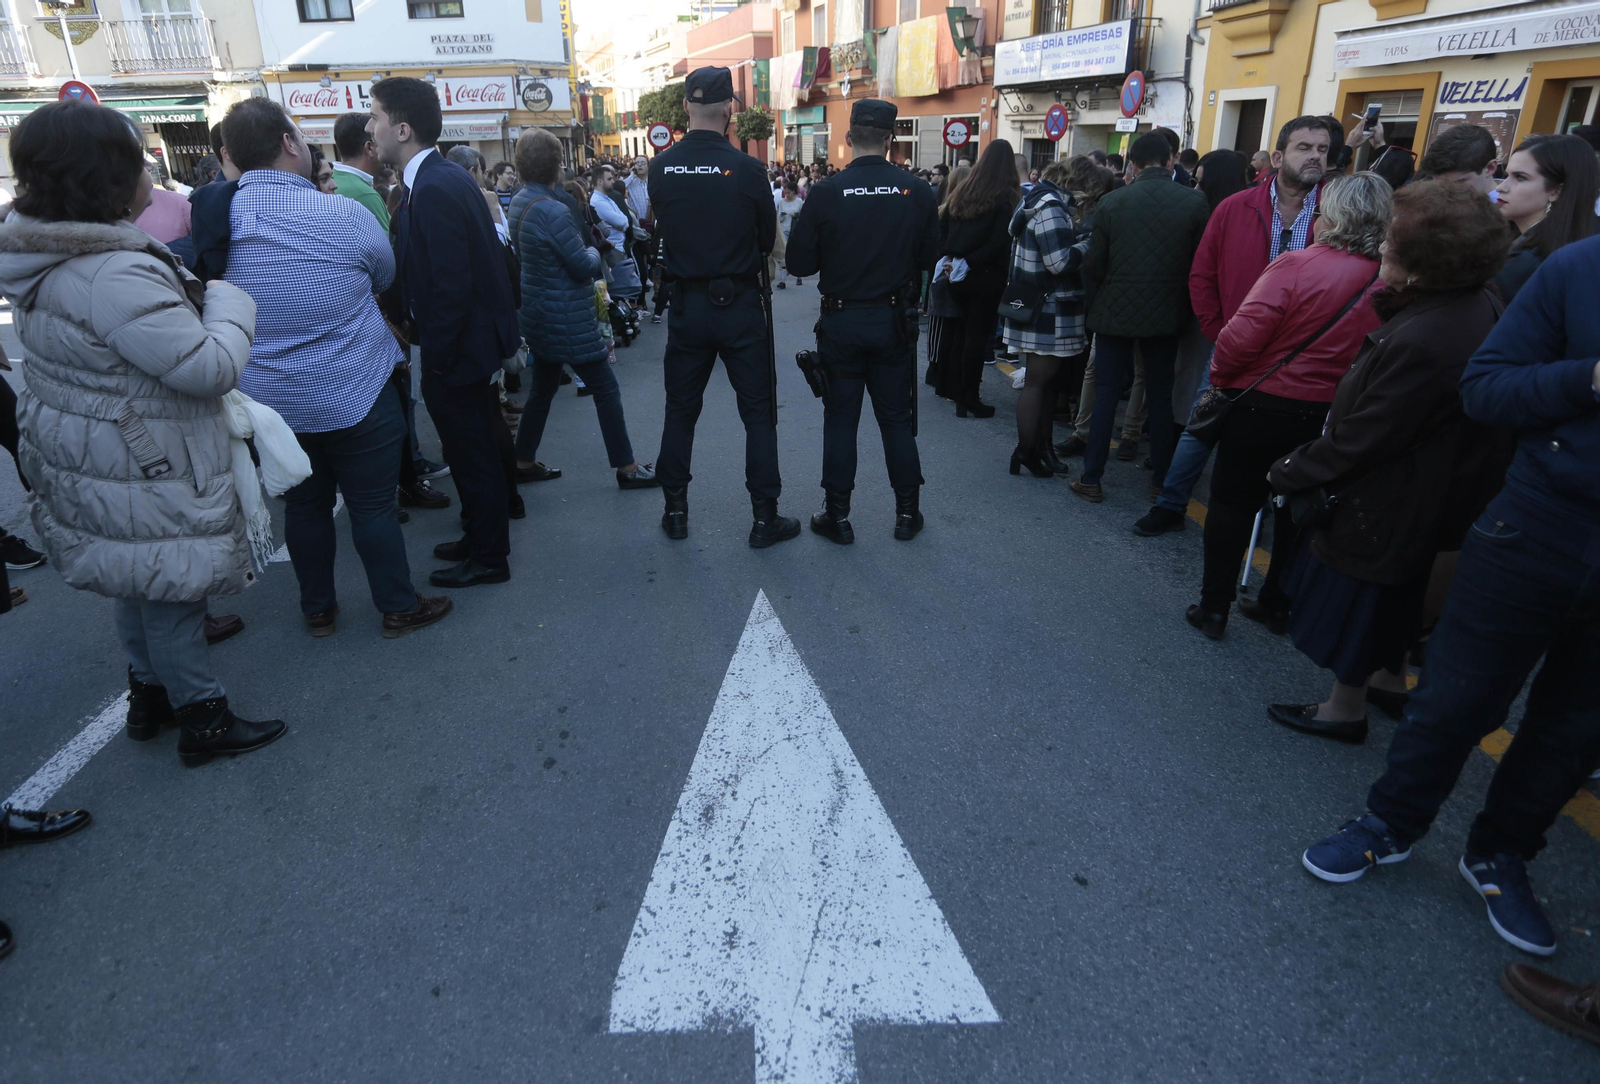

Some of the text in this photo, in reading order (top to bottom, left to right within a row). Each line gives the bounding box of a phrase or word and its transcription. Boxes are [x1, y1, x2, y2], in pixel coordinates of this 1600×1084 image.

[1554, 14, 1600, 30] COCINA
[430, 34, 494, 43] PLAZA DEL
[1020, 27, 1122, 52] ASESORÍA EMPRESAS
[1437, 27, 1517, 52] VELELLA
[1533, 26, 1600, 44] DE MERCA
[436, 45, 492, 54] ALTOZANO
[1103, 43, 1121, 52] FISCAL
[1383, 45, 1409, 57] TAPAS
[455, 83, 508, 103] Coca-Cola
[1439, 76, 1529, 104] VELELLA
[289, 88, 339, 108] Coca-Cola
[140, 114, 196, 123] TAPAS-COPAS
[442, 128, 465, 137] APAS
[664, 166, 721, 174] POLICIA
[843, 186, 900, 197] POLICIA
